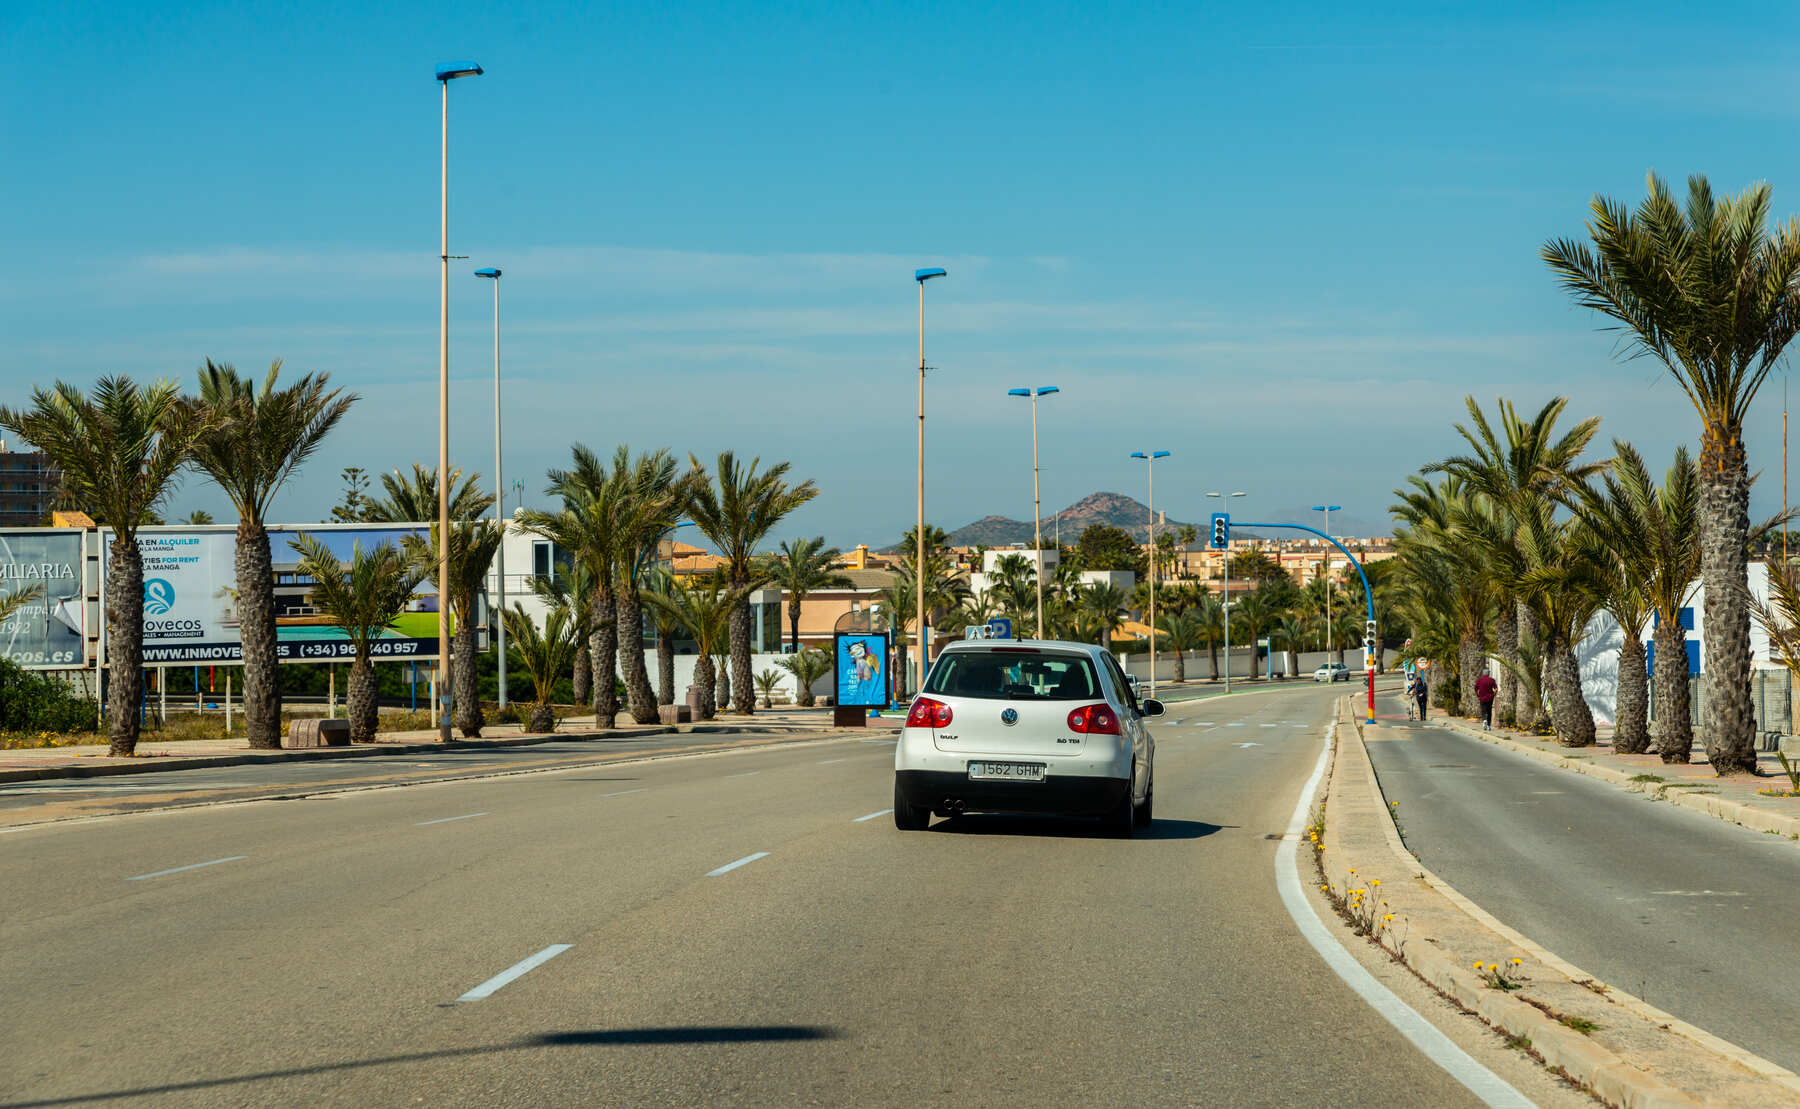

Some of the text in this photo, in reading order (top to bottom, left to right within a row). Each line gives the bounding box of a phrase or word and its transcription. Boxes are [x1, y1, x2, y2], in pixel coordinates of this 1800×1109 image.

[158, 537, 200, 547] ALQUILER
[161, 556, 178, 564] FOR
[152, 563, 180, 571] MANGA
[144, 619, 202, 631] ovecos
[992, 622, 1007, 640] P
[163, 630, 202, 638] MANAGEMENT
[299, 643, 336, 657] (+34)
[339, 644, 357, 655] 96
[393, 642, 419, 654] 957
[11, 650, 74, 663] cos.es
[983, 764, 1040, 777] 1562 GHM
